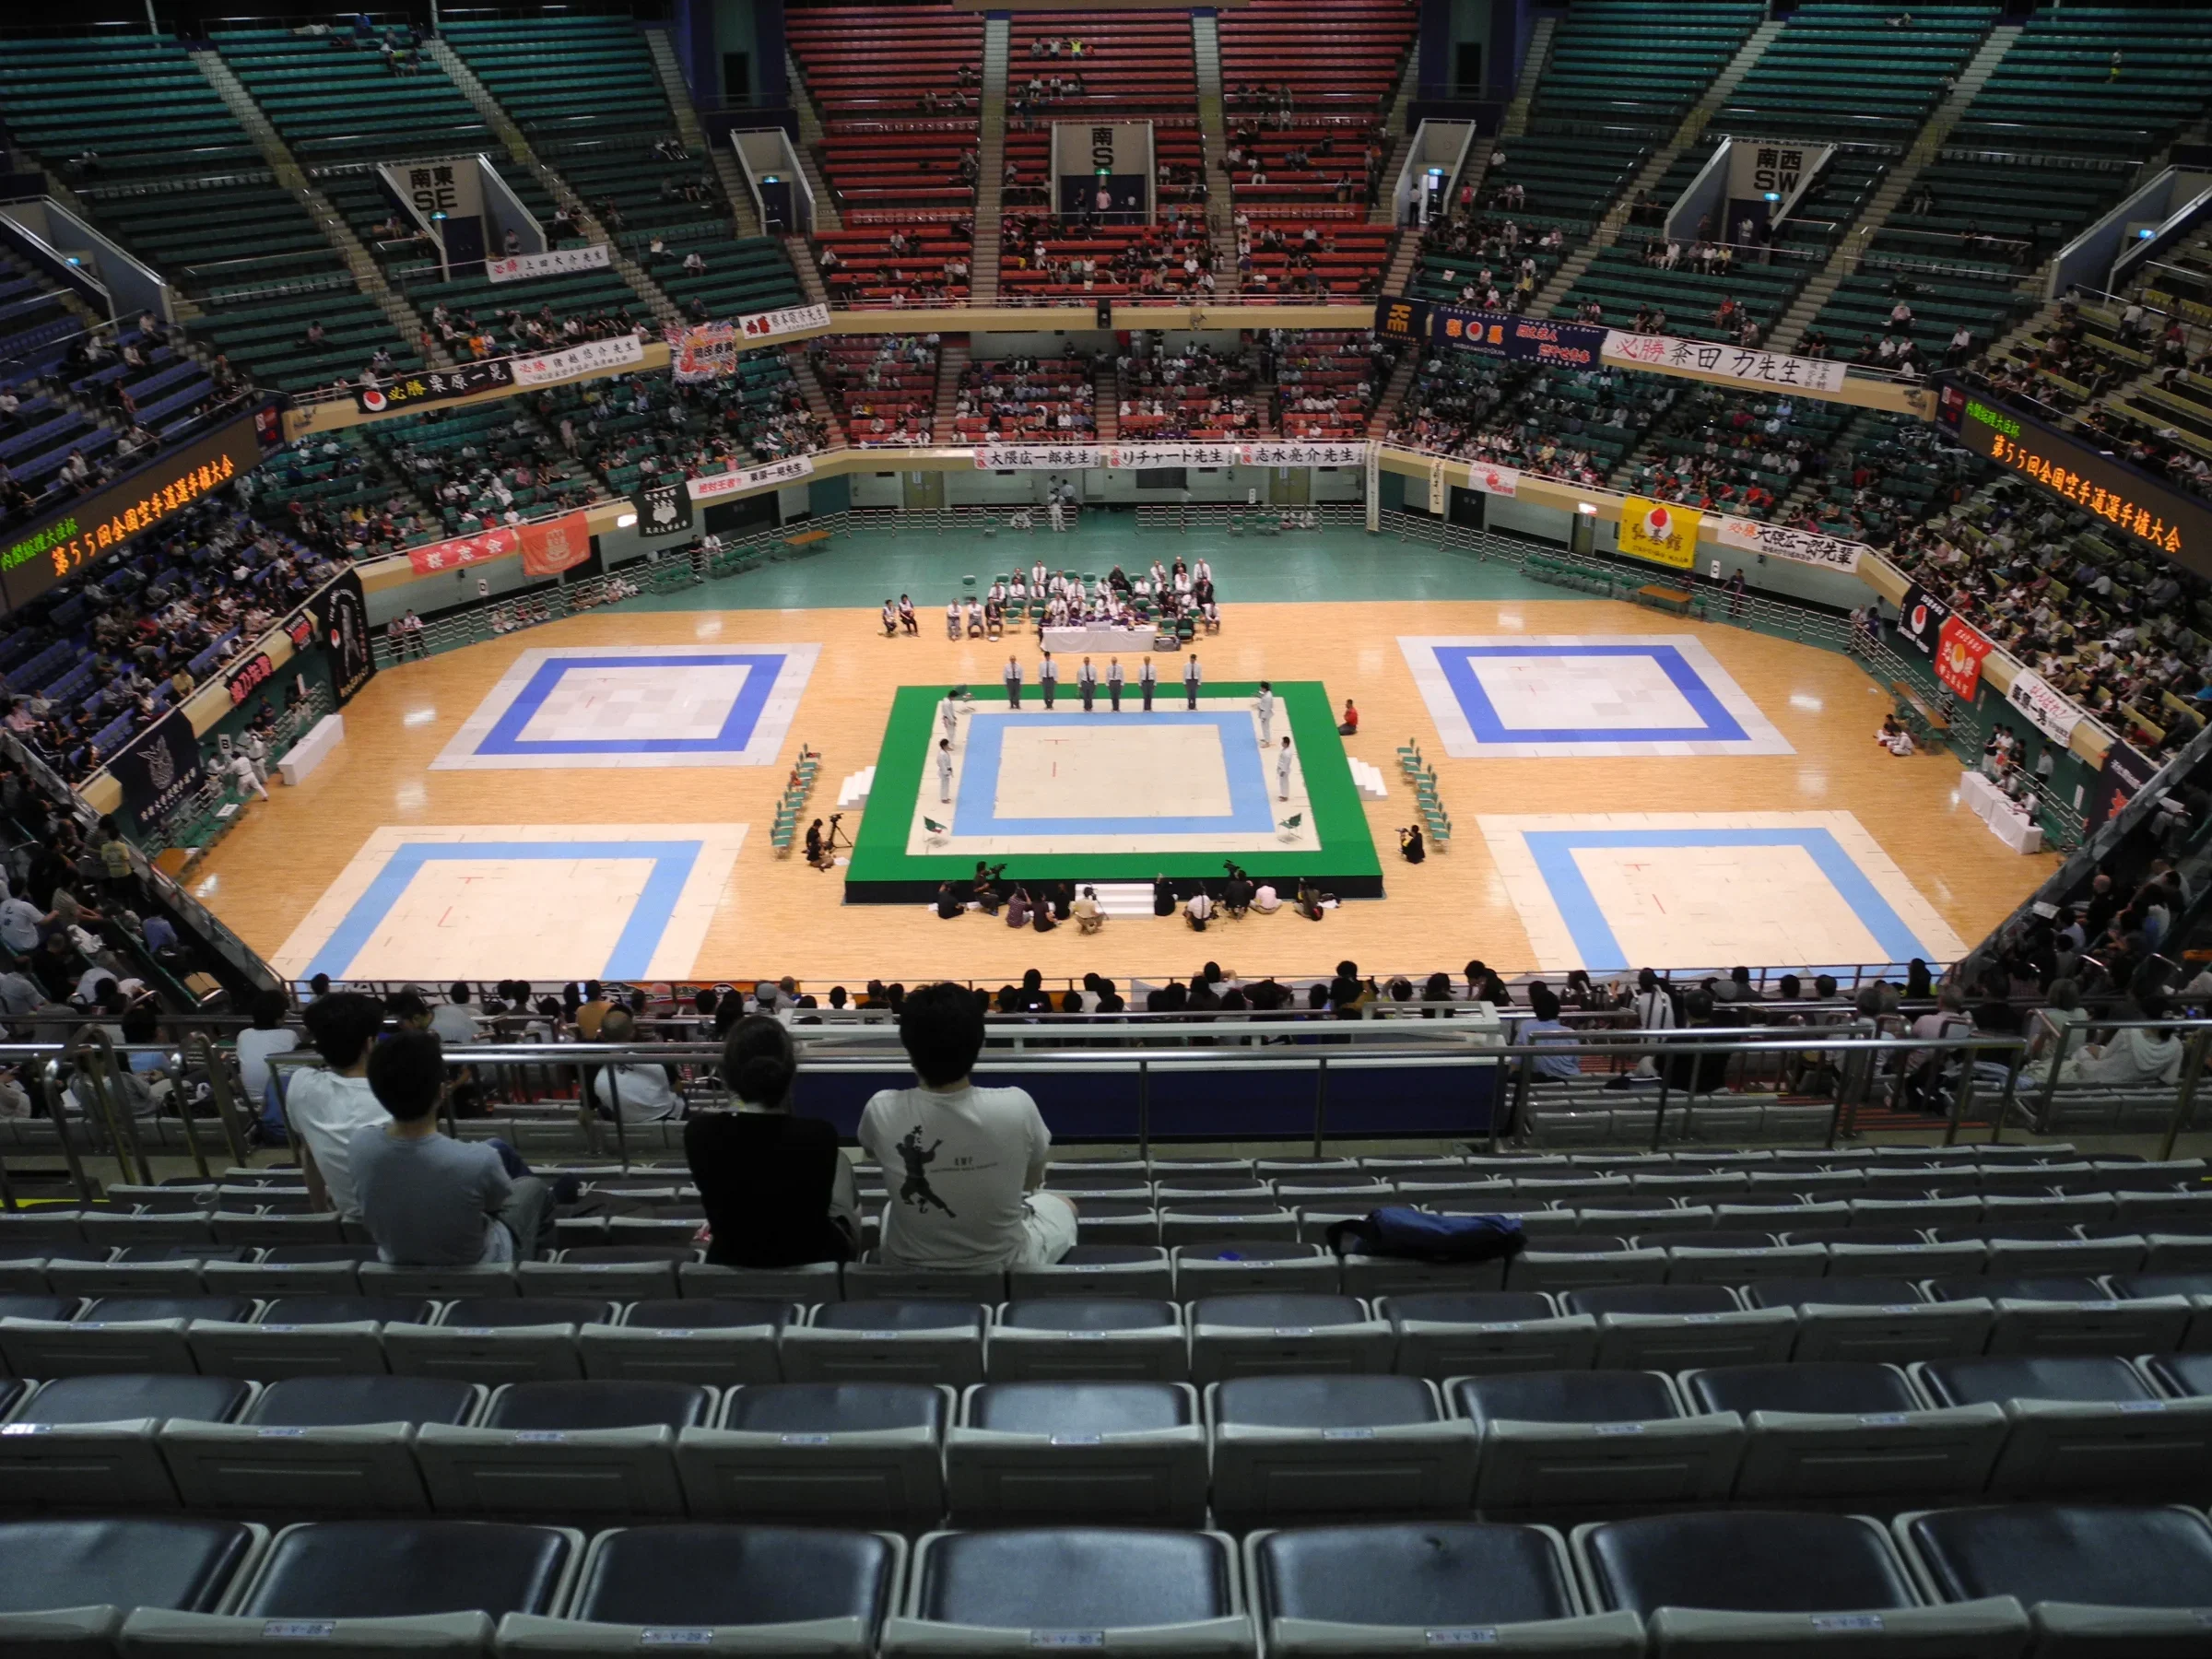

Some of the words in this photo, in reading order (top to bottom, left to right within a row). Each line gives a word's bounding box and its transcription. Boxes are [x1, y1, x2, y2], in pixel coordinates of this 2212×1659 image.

[1092, 127, 1113, 146] 南
[1092, 147, 1114, 167] S
[1757, 147, 1803, 171] 南西
[409, 166, 453, 189] 南東
[1753, 170, 1800, 194] SW
[413, 187, 458, 211] SE
[1617, 337, 1665, 363] 必勝
[387, 379, 427, 401] 必勝
[991, 450, 1090, 465] 大隈広一郎先生
[1123, 448, 1223, 465] リチャード先生
[1256, 447, 1355, 463] 志水亮介先生
[1631, 523, 1684, 552] 弘基館
[1754, 525, 1856, 565] 大隈広一郎先輩
[221, 739, 230, 749] B
